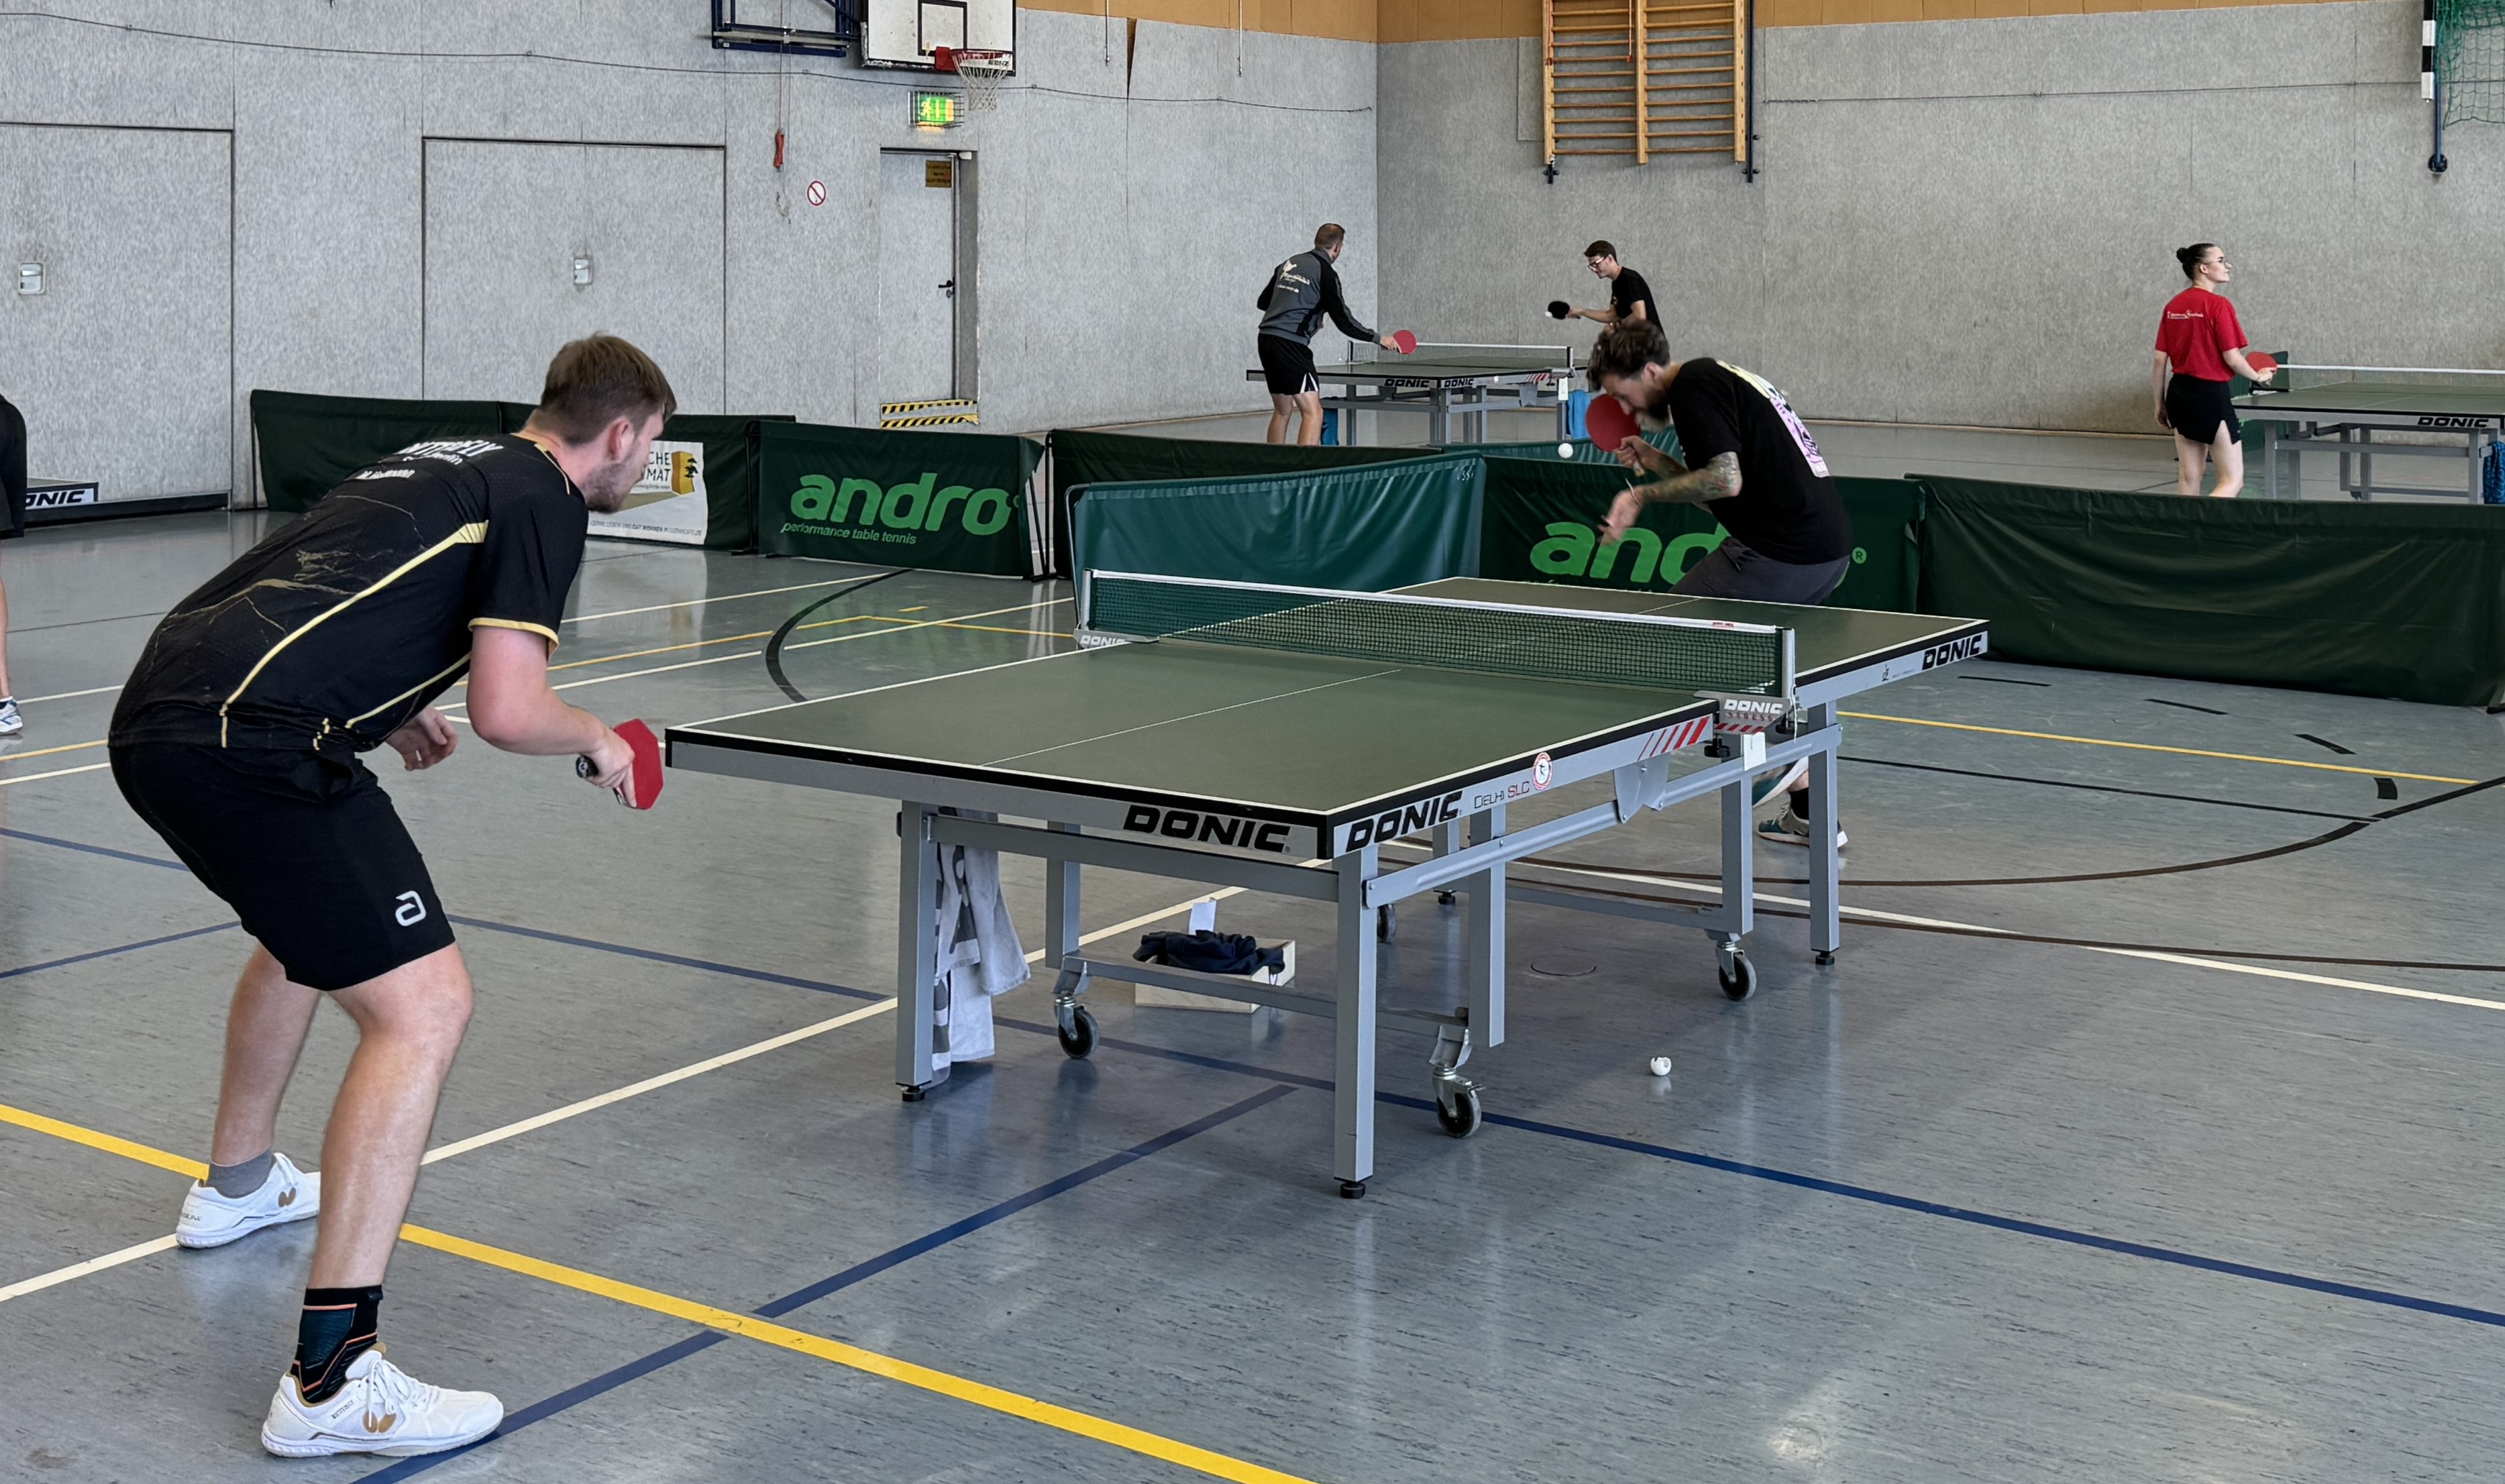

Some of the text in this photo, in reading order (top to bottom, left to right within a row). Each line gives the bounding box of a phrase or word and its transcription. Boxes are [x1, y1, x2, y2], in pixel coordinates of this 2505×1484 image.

[1384, 378, 1430, 388] DONIC
[1443, 377, 1474, 388] DONIC
[2417, 416, 2489, 428] DONIC
[790, 472, 1013, 536] andro
[780, 522, 917, 544] performance table tennis
[1922, 634, 1983, 671] DONIC
[1724, 699, 1783, 714] DONIC
[1346, 790, 1463, 853] DONIC
[1507, 780, 1530, 798] SLC
[1123, 805, 1291, 853] DONIC
